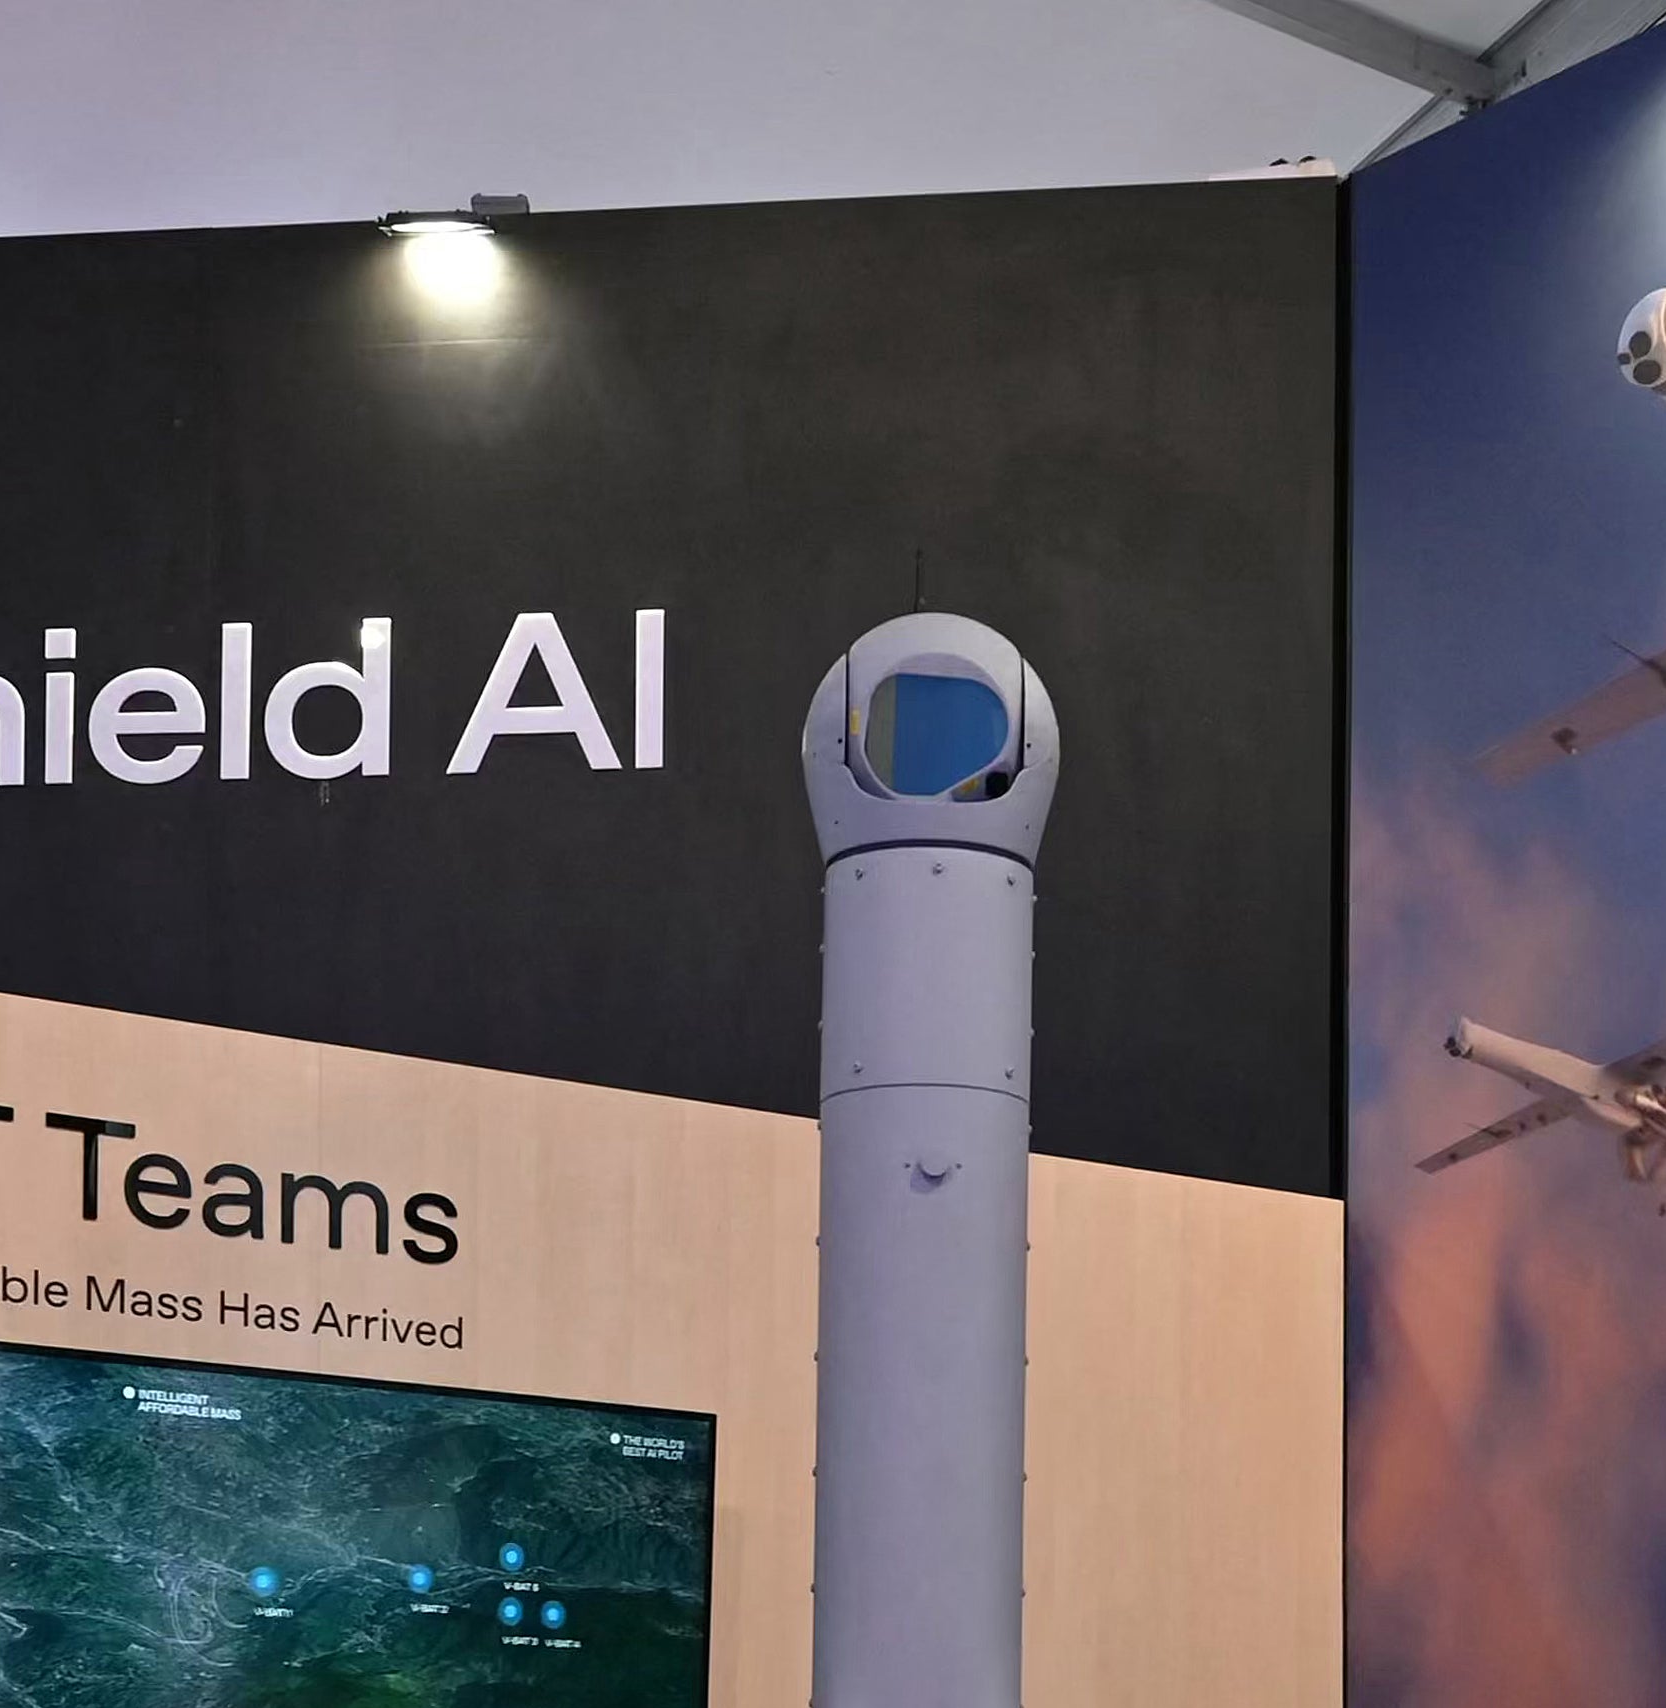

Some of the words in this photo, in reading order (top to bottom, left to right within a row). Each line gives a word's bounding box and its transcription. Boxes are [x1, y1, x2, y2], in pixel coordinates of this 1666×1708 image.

[446, 608, 666, 776] AI
[45, 1112, 461, 1266] Teams
[85, 1275, 204, 1323] Mass
[219, 1290, 301, 1334] Has
[311, 1300, 465, 1350] Arrived
[138, 1390, 210, 1404] INTELLIGENT
[137, 1402, 209, 1417] AFFORDABLE
[210, 1409, 241, 1420] MASS
[622, 1434, 643, 1446] THE
[622, 1445, 646, 1457] BEST
[658, 1449, 684, 1460] PILOT
